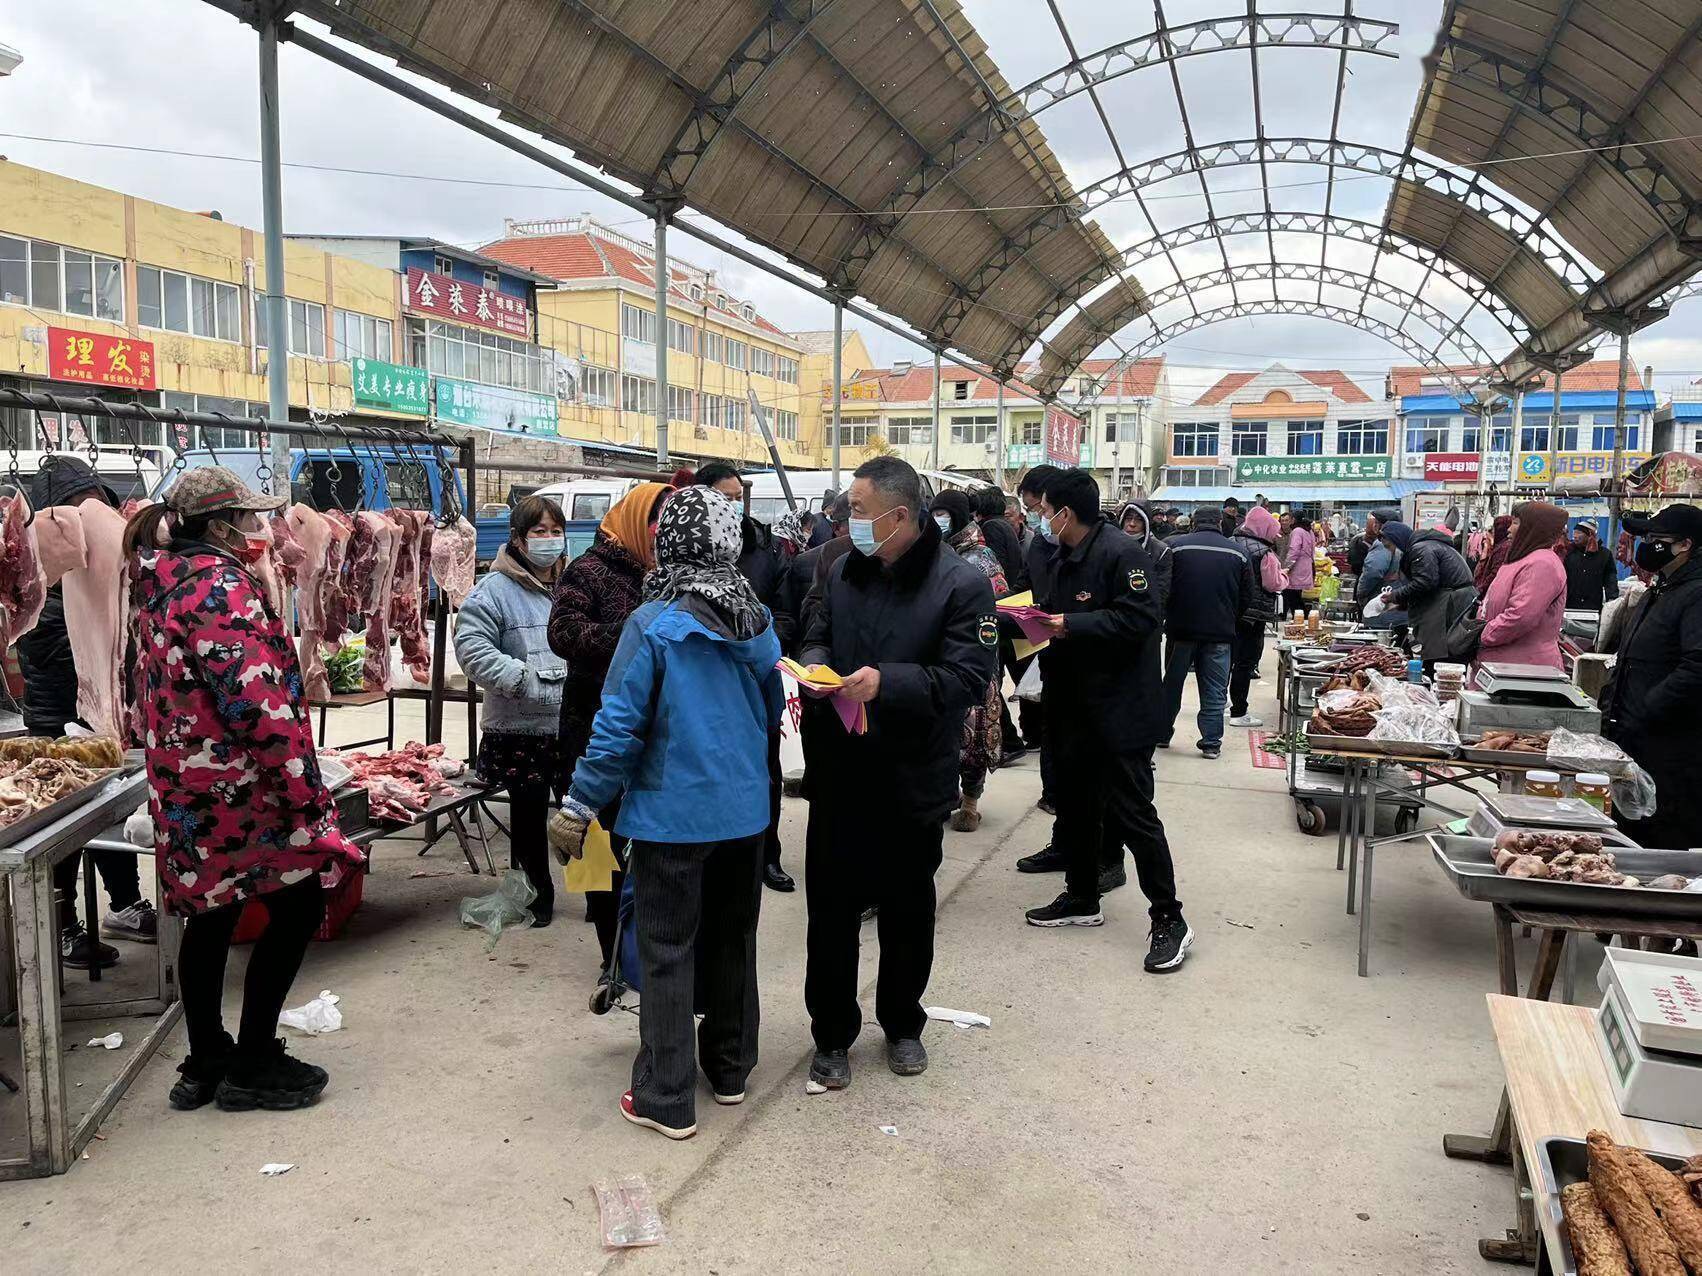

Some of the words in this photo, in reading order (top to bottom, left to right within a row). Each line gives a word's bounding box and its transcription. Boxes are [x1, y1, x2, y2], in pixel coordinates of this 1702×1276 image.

[66, 336, 133, 376] 理发
[1426, 461, 1479, 472] 天能电池
